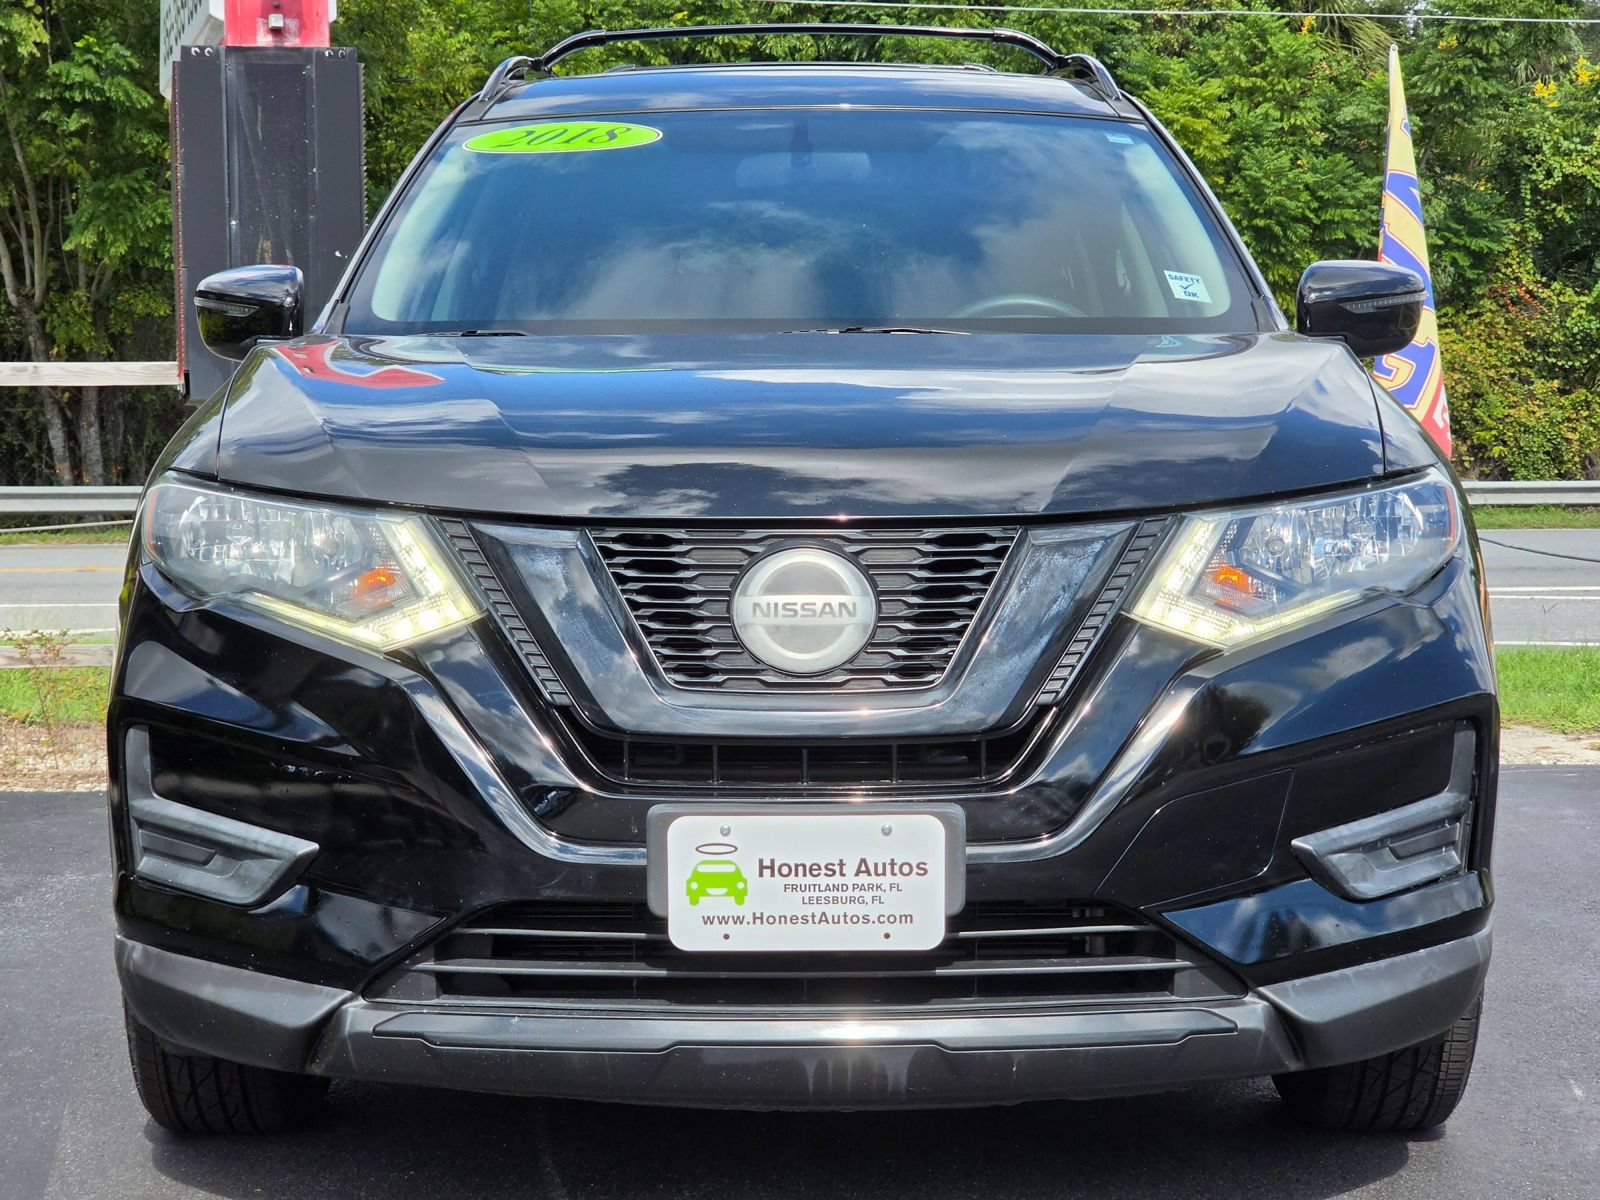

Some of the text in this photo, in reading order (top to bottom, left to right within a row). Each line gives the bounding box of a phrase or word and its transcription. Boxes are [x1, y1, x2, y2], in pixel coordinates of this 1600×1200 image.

[489, 126, 632, 149] 2018
[1168, 273, 1200, 284] SAFETY
[1183, 290, 1200, 299] OK
[752, 602, 857, 618] NISSAN
[757, 857, 929, 878] Honest Autos
[783, 882, 903, 893] FRUITLAND PARK, FL
[801, 895, 885, 906] LEESBURG, FL
[701, 911, 914, 926] www.HonestAutos.com
